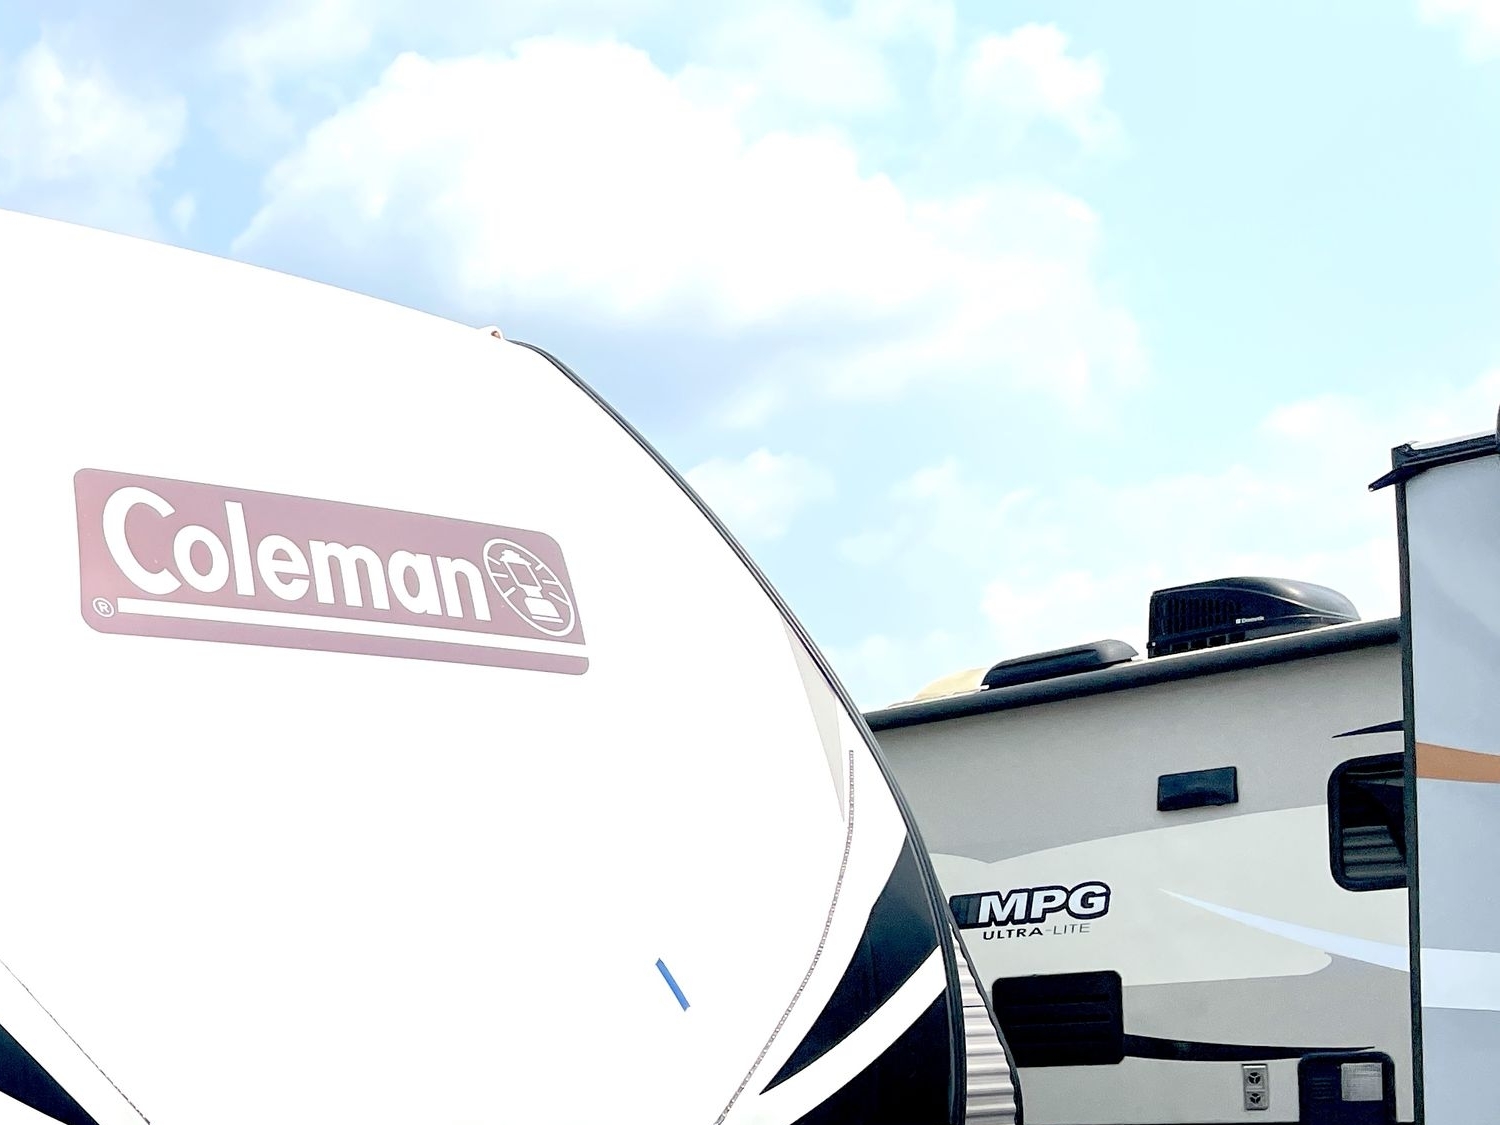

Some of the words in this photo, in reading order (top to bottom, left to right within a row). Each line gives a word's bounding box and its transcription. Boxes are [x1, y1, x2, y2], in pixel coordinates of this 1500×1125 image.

[102, 486, 491, 622] Coleman
[977, 883, 1109, 924] MPG
[983, 923, 1090, 940] ULTRA-LITE
